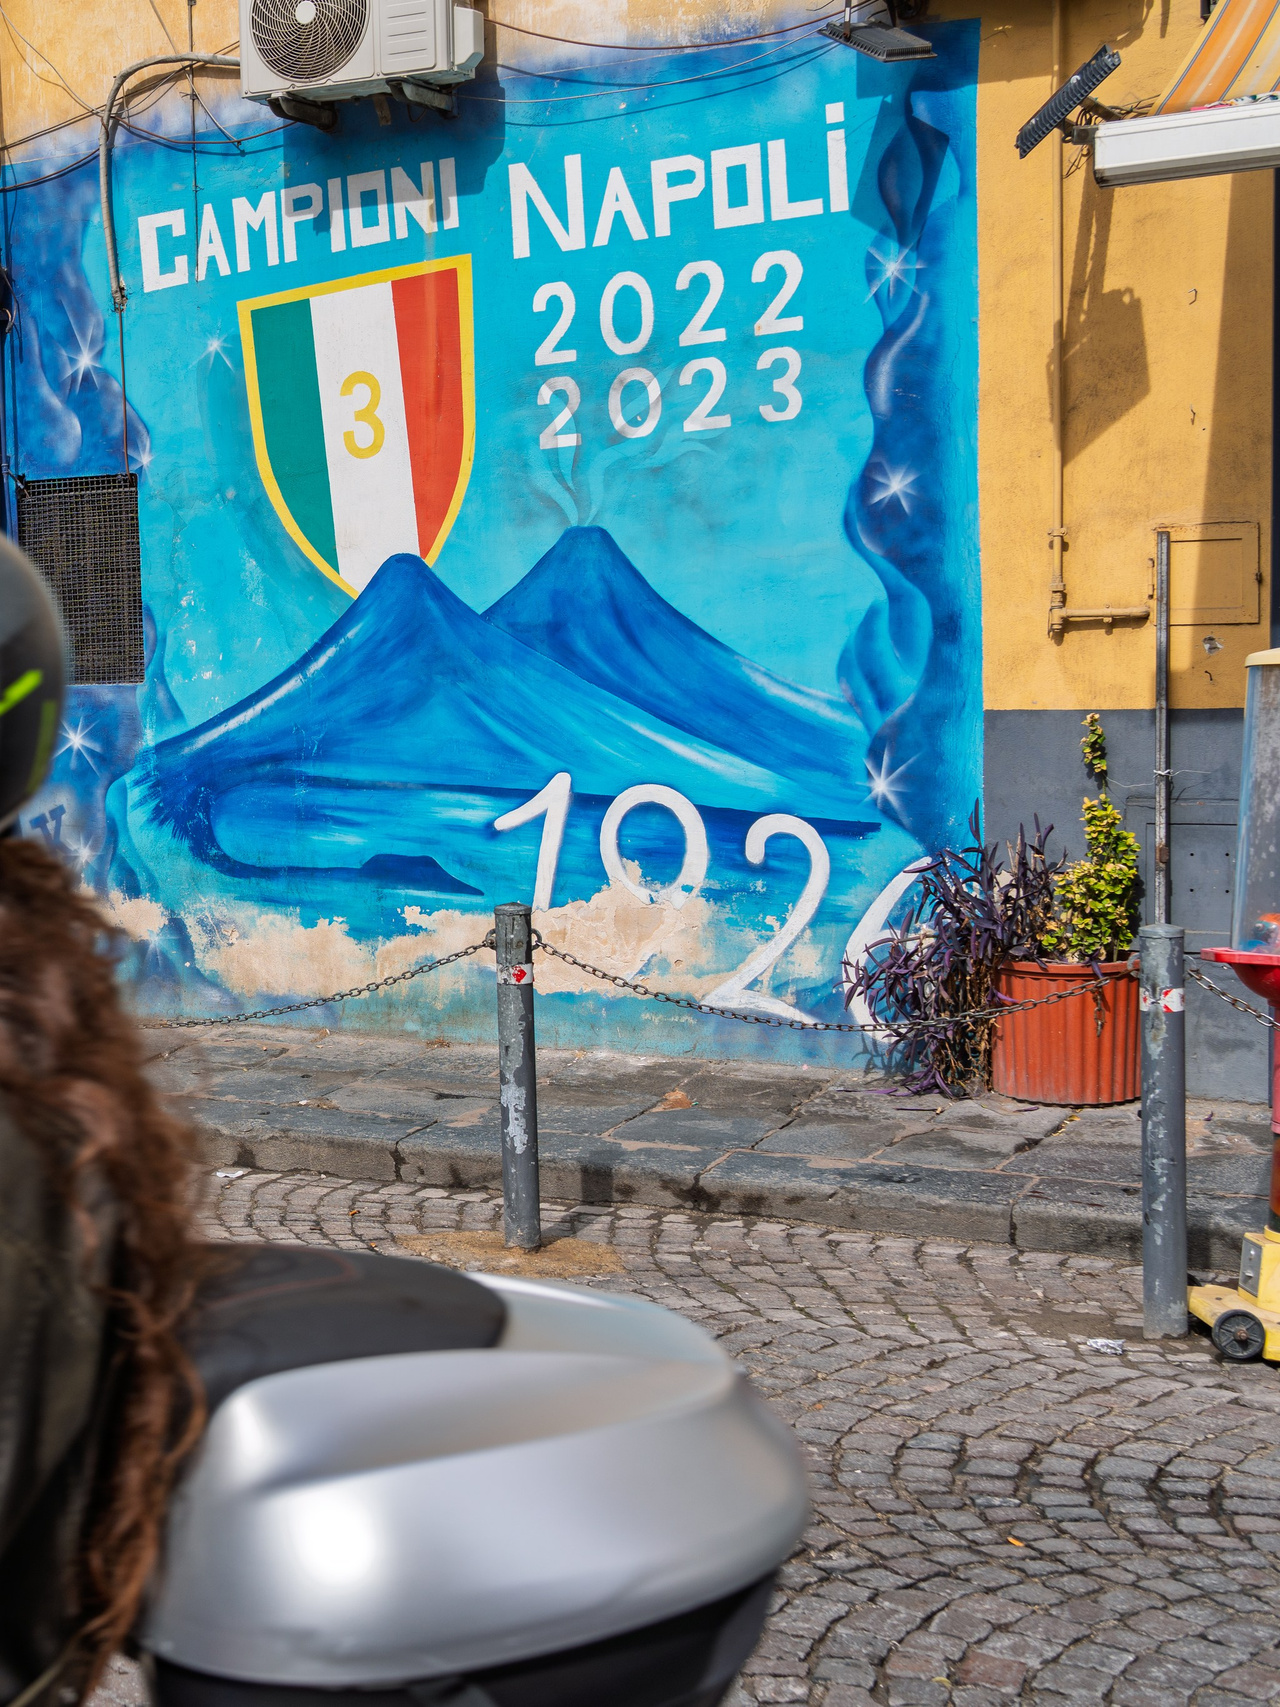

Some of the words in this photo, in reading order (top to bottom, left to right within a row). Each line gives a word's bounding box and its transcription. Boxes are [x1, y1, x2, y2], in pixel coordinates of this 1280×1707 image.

[138, 157, 460, 293] CAMPIONI
[531, 249, 805, 366] 2022
[338, 370, 386, 460] 3
[536, 346, 804, 450] 2023
